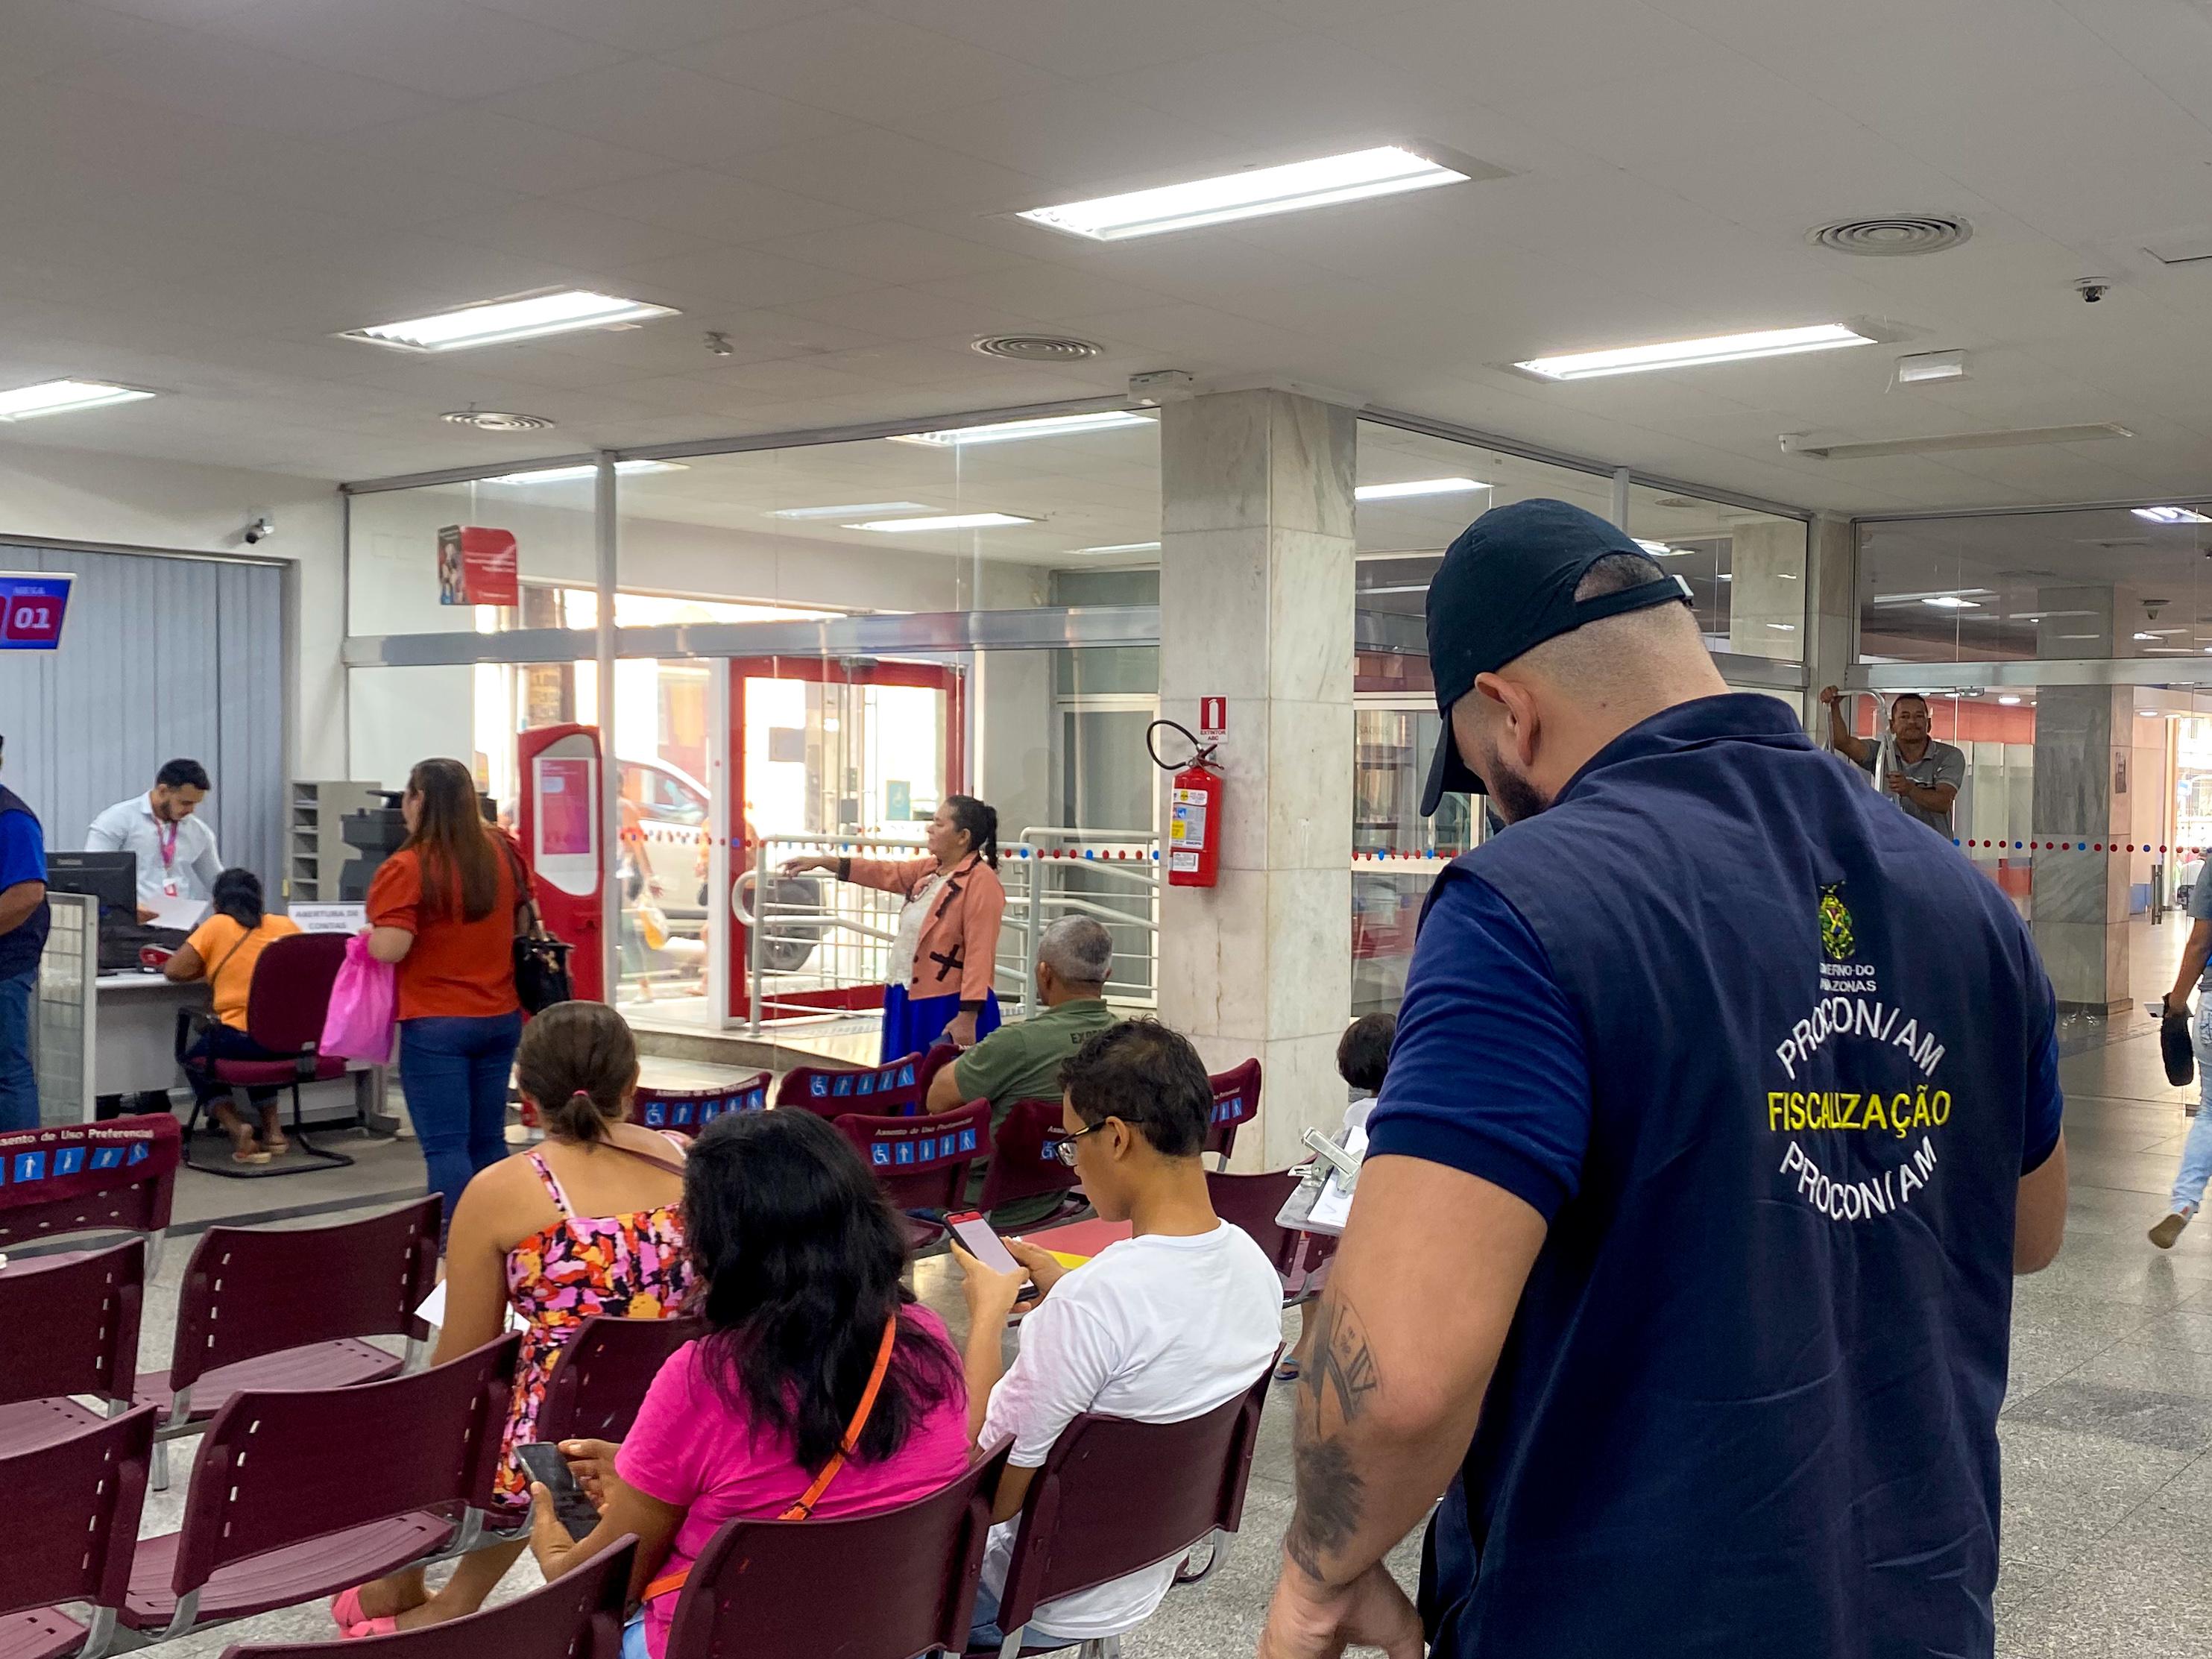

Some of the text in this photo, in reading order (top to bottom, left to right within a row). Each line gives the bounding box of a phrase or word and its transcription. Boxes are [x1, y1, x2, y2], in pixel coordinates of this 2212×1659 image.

[14, 607, 51, 629] 01
[1768, 1084, 1952, 1139] FISCALIZAÇÃO
[0, 1134, 36, 1147] sento
